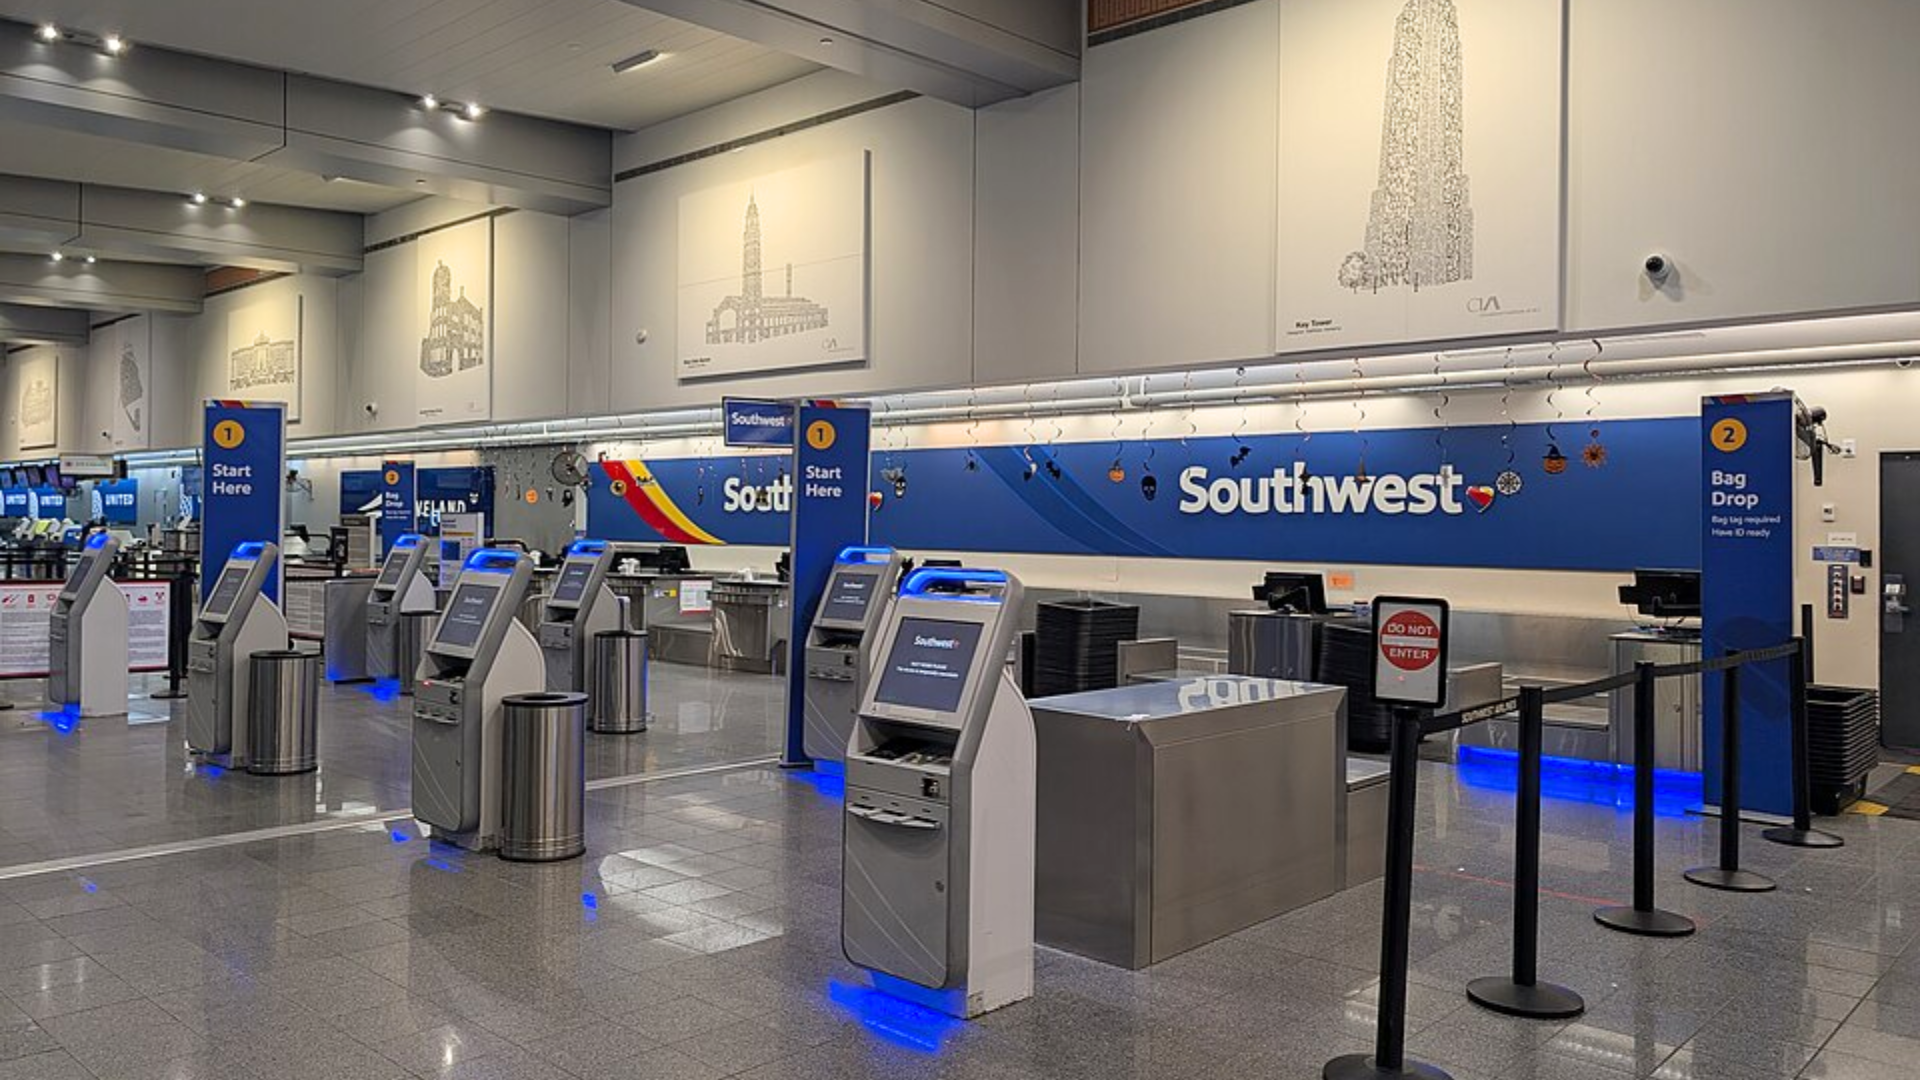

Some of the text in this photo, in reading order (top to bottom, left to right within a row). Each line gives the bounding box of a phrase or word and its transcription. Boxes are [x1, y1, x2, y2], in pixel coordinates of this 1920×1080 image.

[731, 411, 785, 427] Southwest
[1723, 427, 1735, 443] 2
[212, 463, 252, 477] Start
[805, 465, 842, 479] Start
[1711, 470, 1746, 489] Bag
[212, 481, 252, 495] Here
[805, 484, 842, 497] Here
[1179, 462, 1463, 514] Southwest
[1711, 491, 1759, 510] Drop
[1387, 623, 1434, 635] DO NOT
[1389, 647, 1430, 660] ENTER
